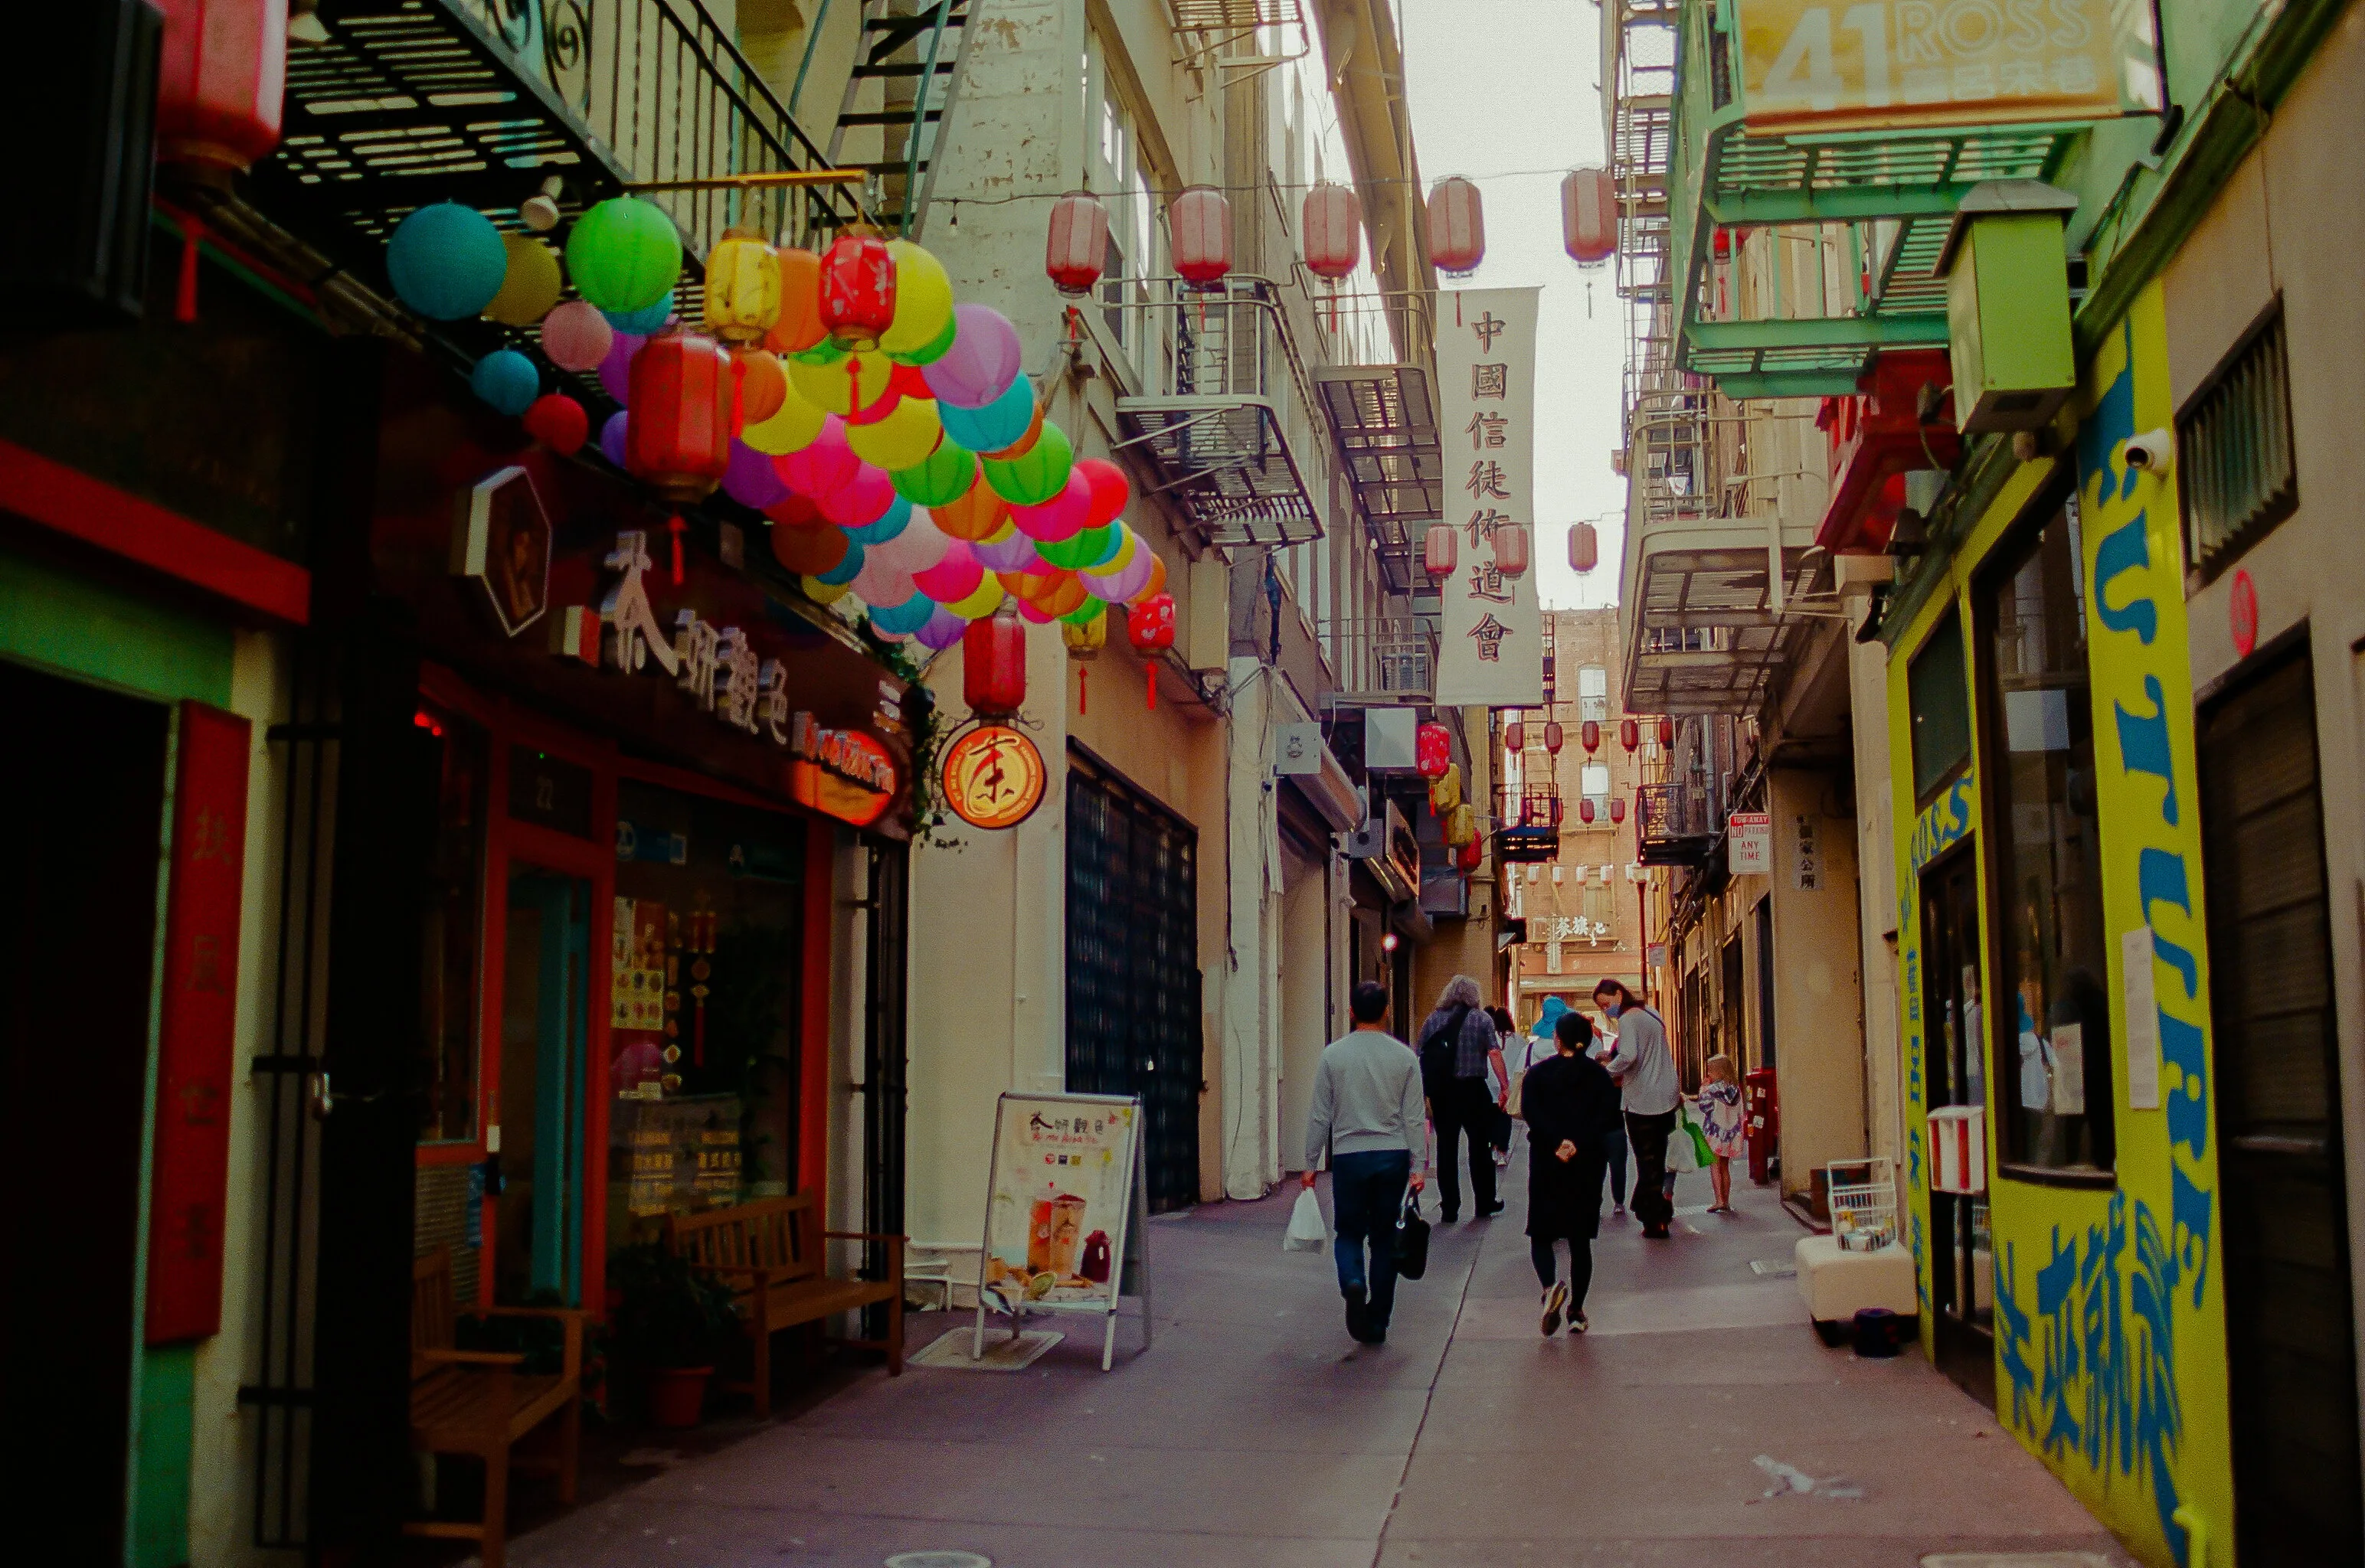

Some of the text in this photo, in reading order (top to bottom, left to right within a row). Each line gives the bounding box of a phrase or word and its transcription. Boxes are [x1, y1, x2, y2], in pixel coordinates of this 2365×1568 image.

[1762, 0, 2090, 111] 41 ROSS
[1731, 825, 1743, 838] NO
[1741, 841, 1759, 850] ANY
[1740, 851, 1760, 861] TIME
